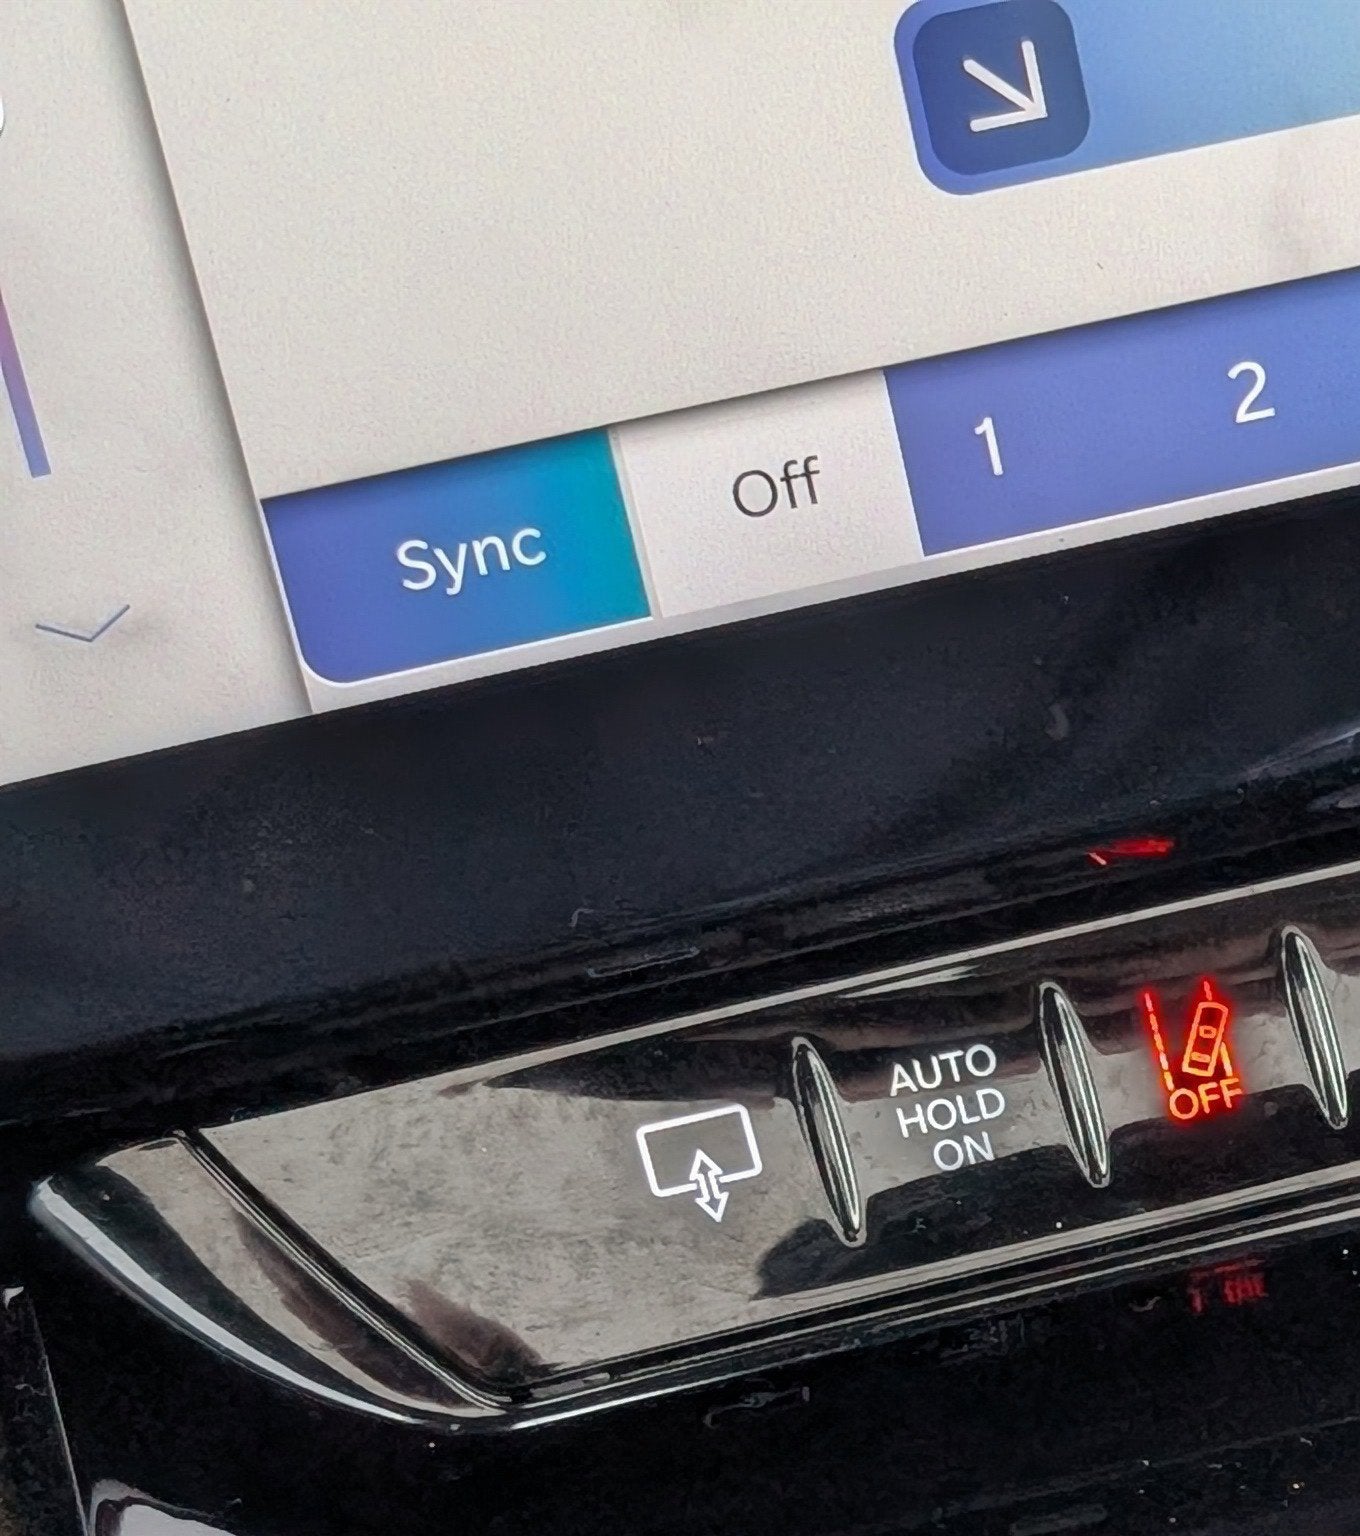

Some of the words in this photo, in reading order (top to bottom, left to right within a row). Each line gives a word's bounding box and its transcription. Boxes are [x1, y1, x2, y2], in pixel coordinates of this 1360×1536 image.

[1228, 361, 1276, 424] 2
[973, 416, 1003, 476] 1
[732, 456, 821, 519] Off
[396, 524, 547, 596] Sync
[890, 1044, 996, 1097] AUTO
[897, 1088, 1006, 1138] HOLD
[1168, 1078, 1243, 1121] OFF
[932, 1133, 996, 1172] ON
